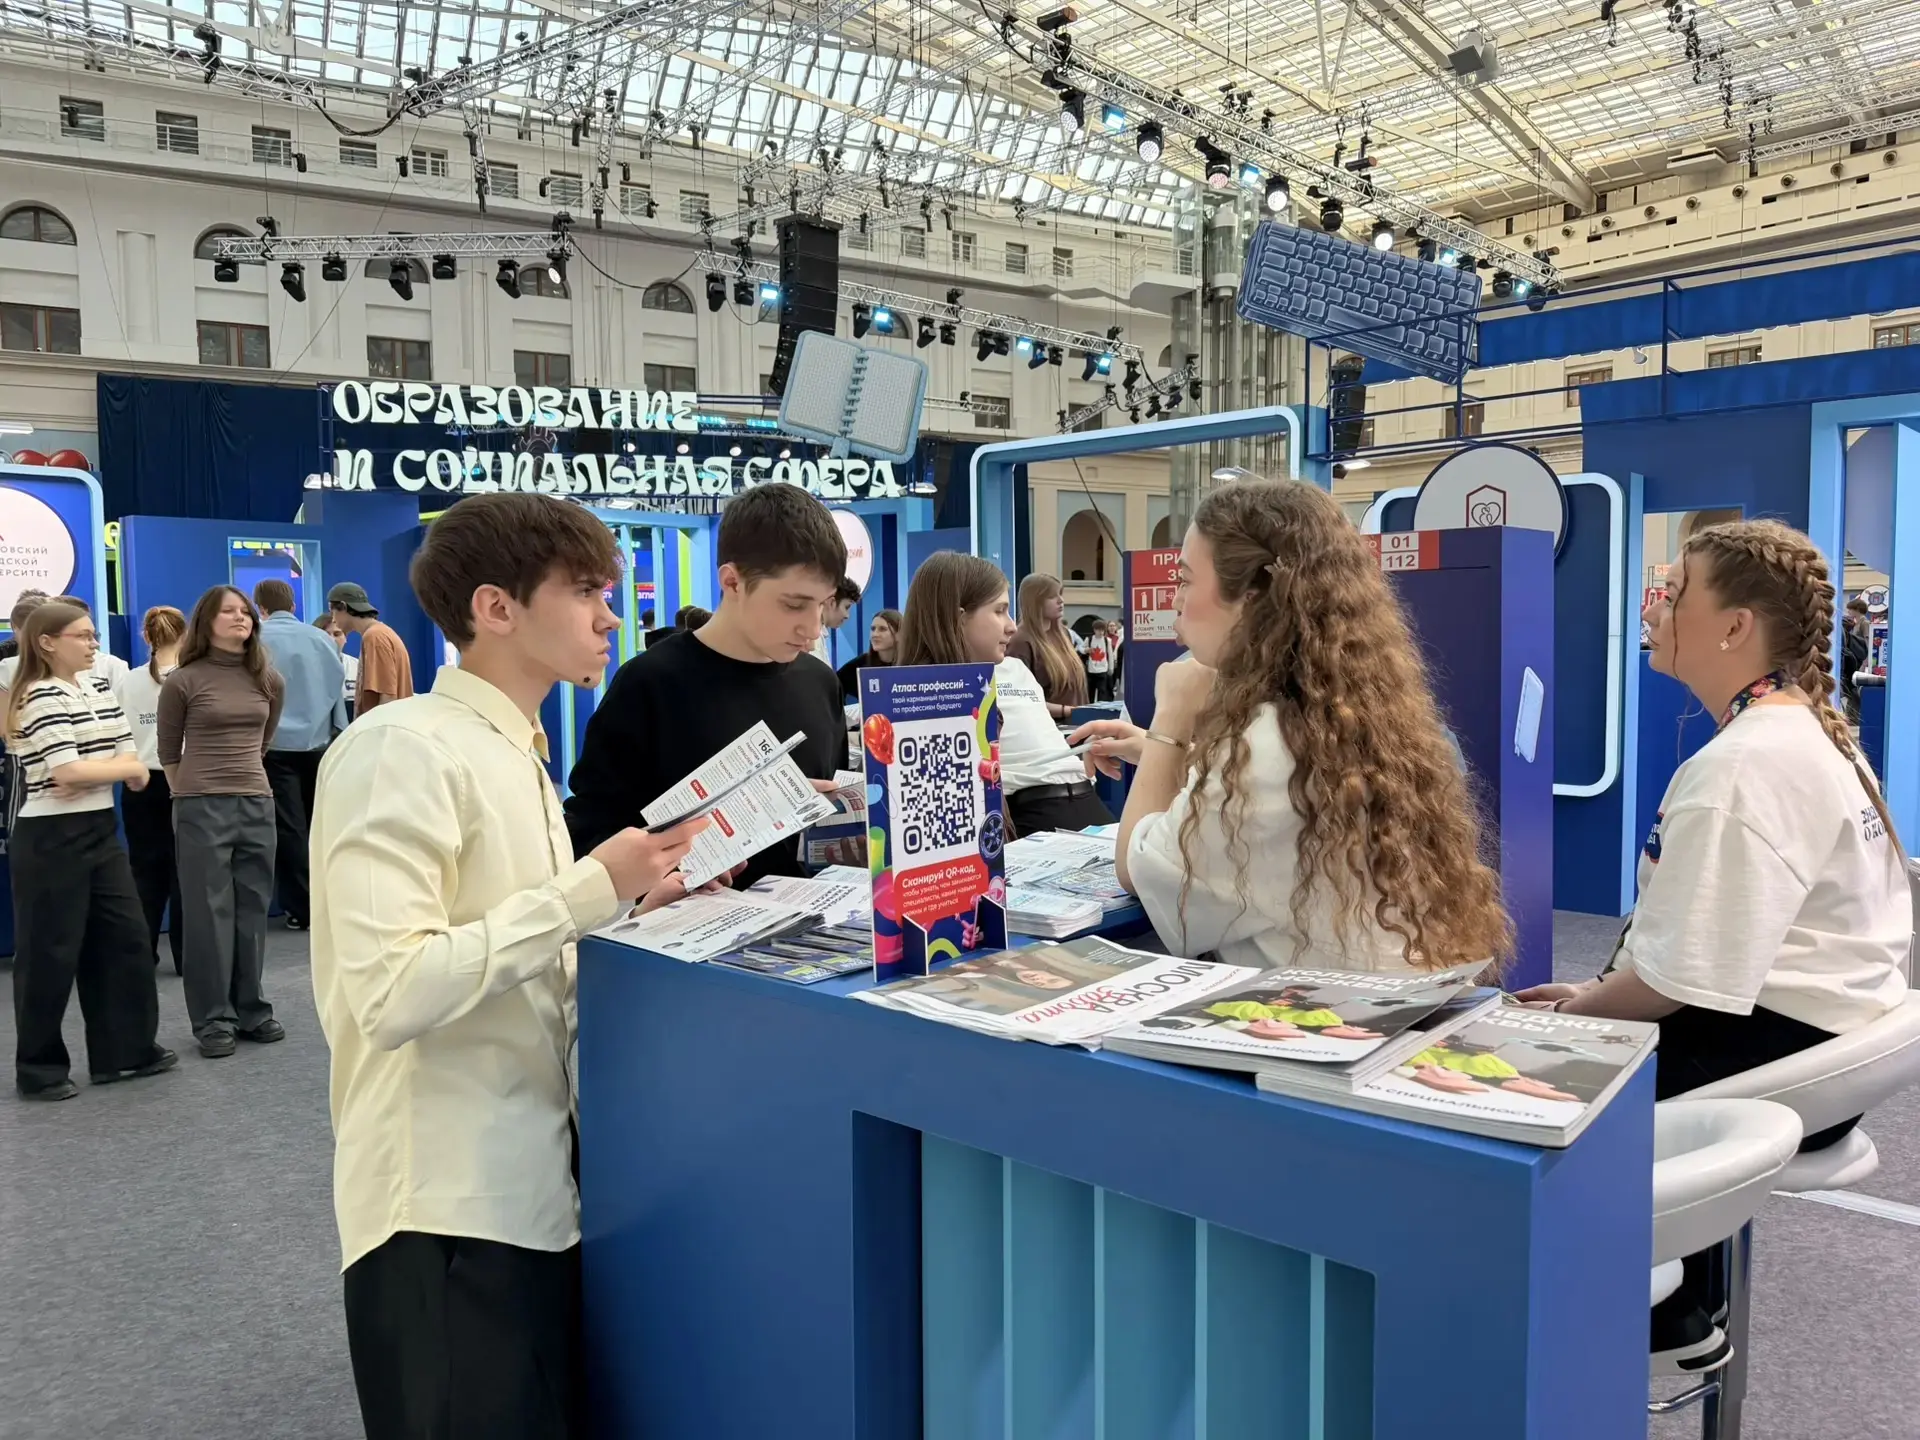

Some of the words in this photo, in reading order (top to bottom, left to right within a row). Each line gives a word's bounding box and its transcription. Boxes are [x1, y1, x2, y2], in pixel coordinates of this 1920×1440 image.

[333, 380, 698, 431] ОБРАЗОВАНИЕ
[337, 448, 377, 491] И
[393, 450, 733, 496] СОЦИАЛЬНАЯ
[743, 457, 902, 498] СФЕРА
[1391, 535, 1410, 549] 01
[1385, 554, 1416, 568] 112
[1134, 613, 1154, 625] ПК-
[891, 683, 917, 693] Атлас
[918, 679, 964, 693] профессий
[936, 702, 962, 711] будущего
[902, 869, 944, 888] Сканируй
[945, 864, 976, 879] QR-код,
[1269, 974, 1404, 992] МОСКВЫ
[1281, 968, 1456, 985] КОЛЛЕДЖИ
[1072, 961, 1216, 1014] МОСКВА
[1385, 1088, 1546, 1119] СПЕЦИАЛЬНОСТЬ
